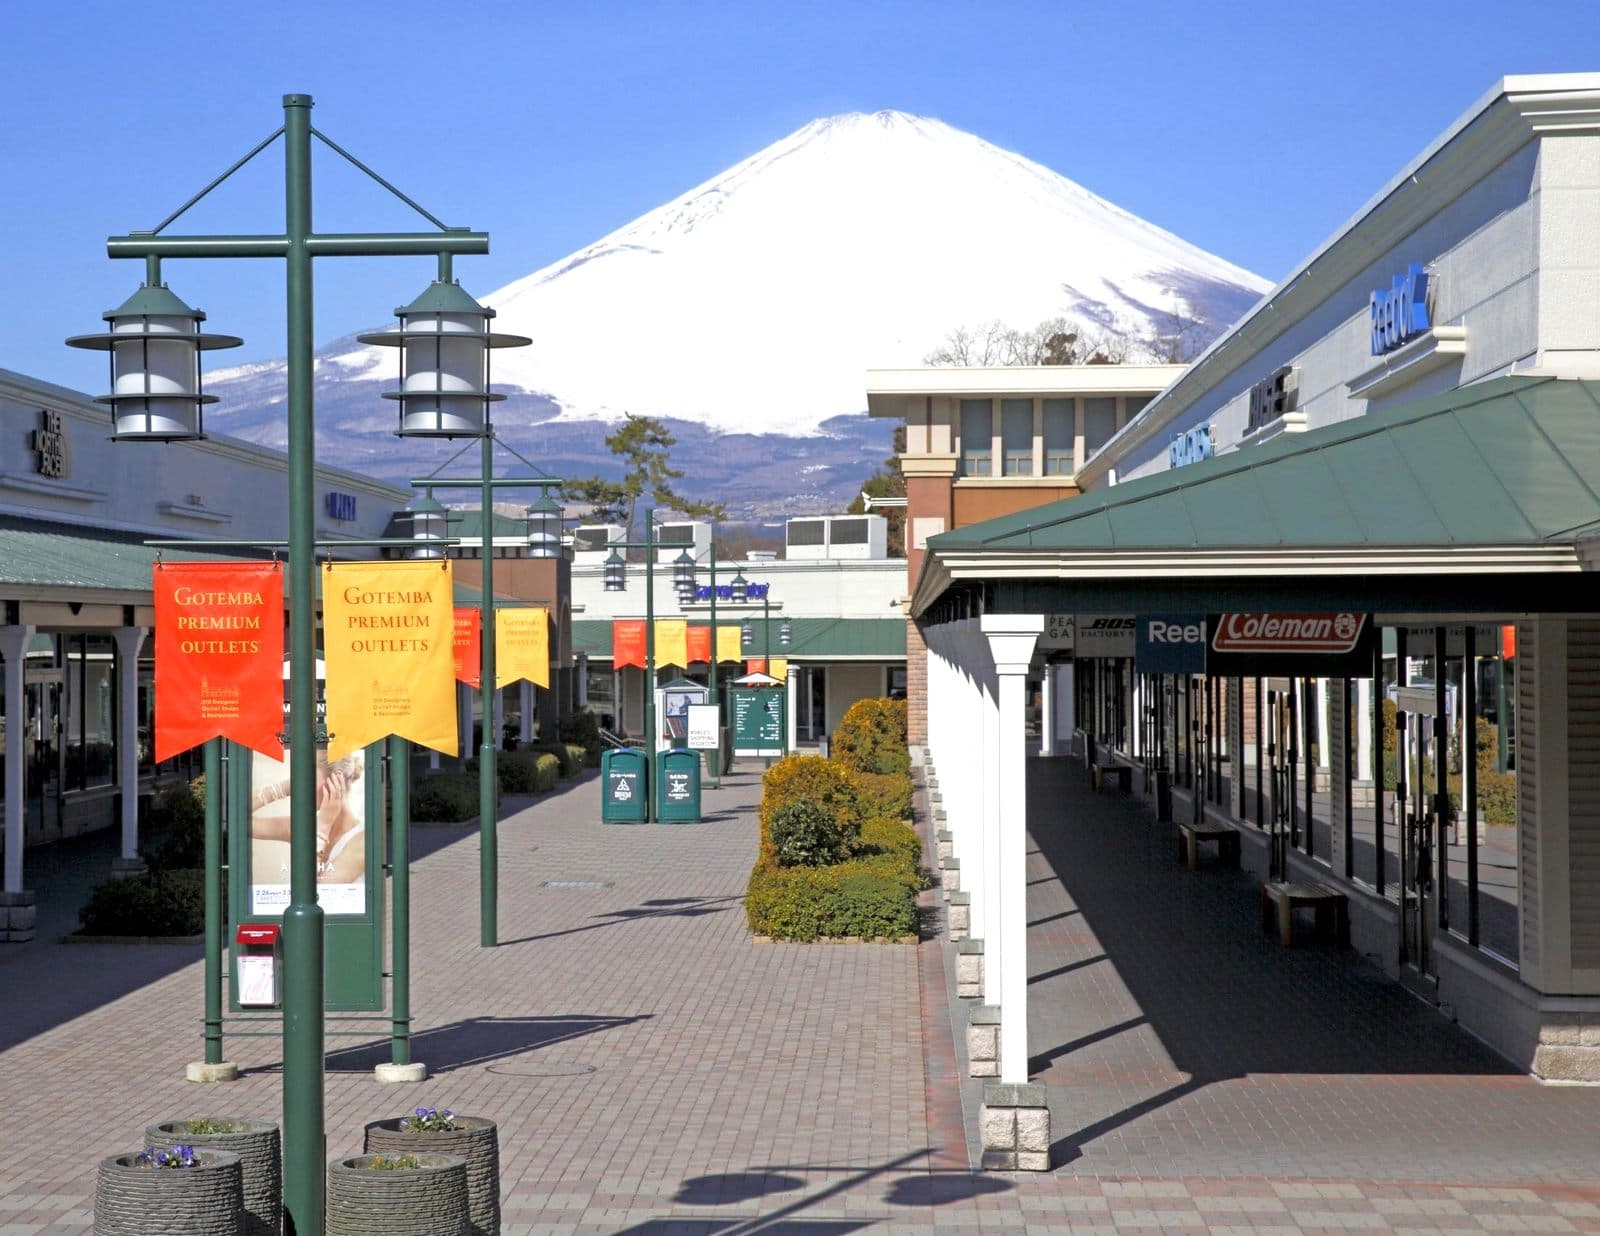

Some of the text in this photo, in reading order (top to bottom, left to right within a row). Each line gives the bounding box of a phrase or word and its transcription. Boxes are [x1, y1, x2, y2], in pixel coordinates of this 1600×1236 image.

[1370, 262, 1429, 356] Reebok
[45, 409, 63, 433] THE
[33, 430, 66, 455] NORTH
[40, 452, 65, 477] FACE
[174, 586, 264, 606] GOTEMBA
[344, 586, 433, 606] GOTEMBA
[177, 616, 260, 630] PREMIUM
[348, 615, 430, 629] PREMIUM
[1228, 613, 1333, 639] Coleman
[1081, 630, 1124, 638] FACTORY
[181, 640, 259, 654] OUTLETS
[351, 639, 429, 653] OUTLETS
